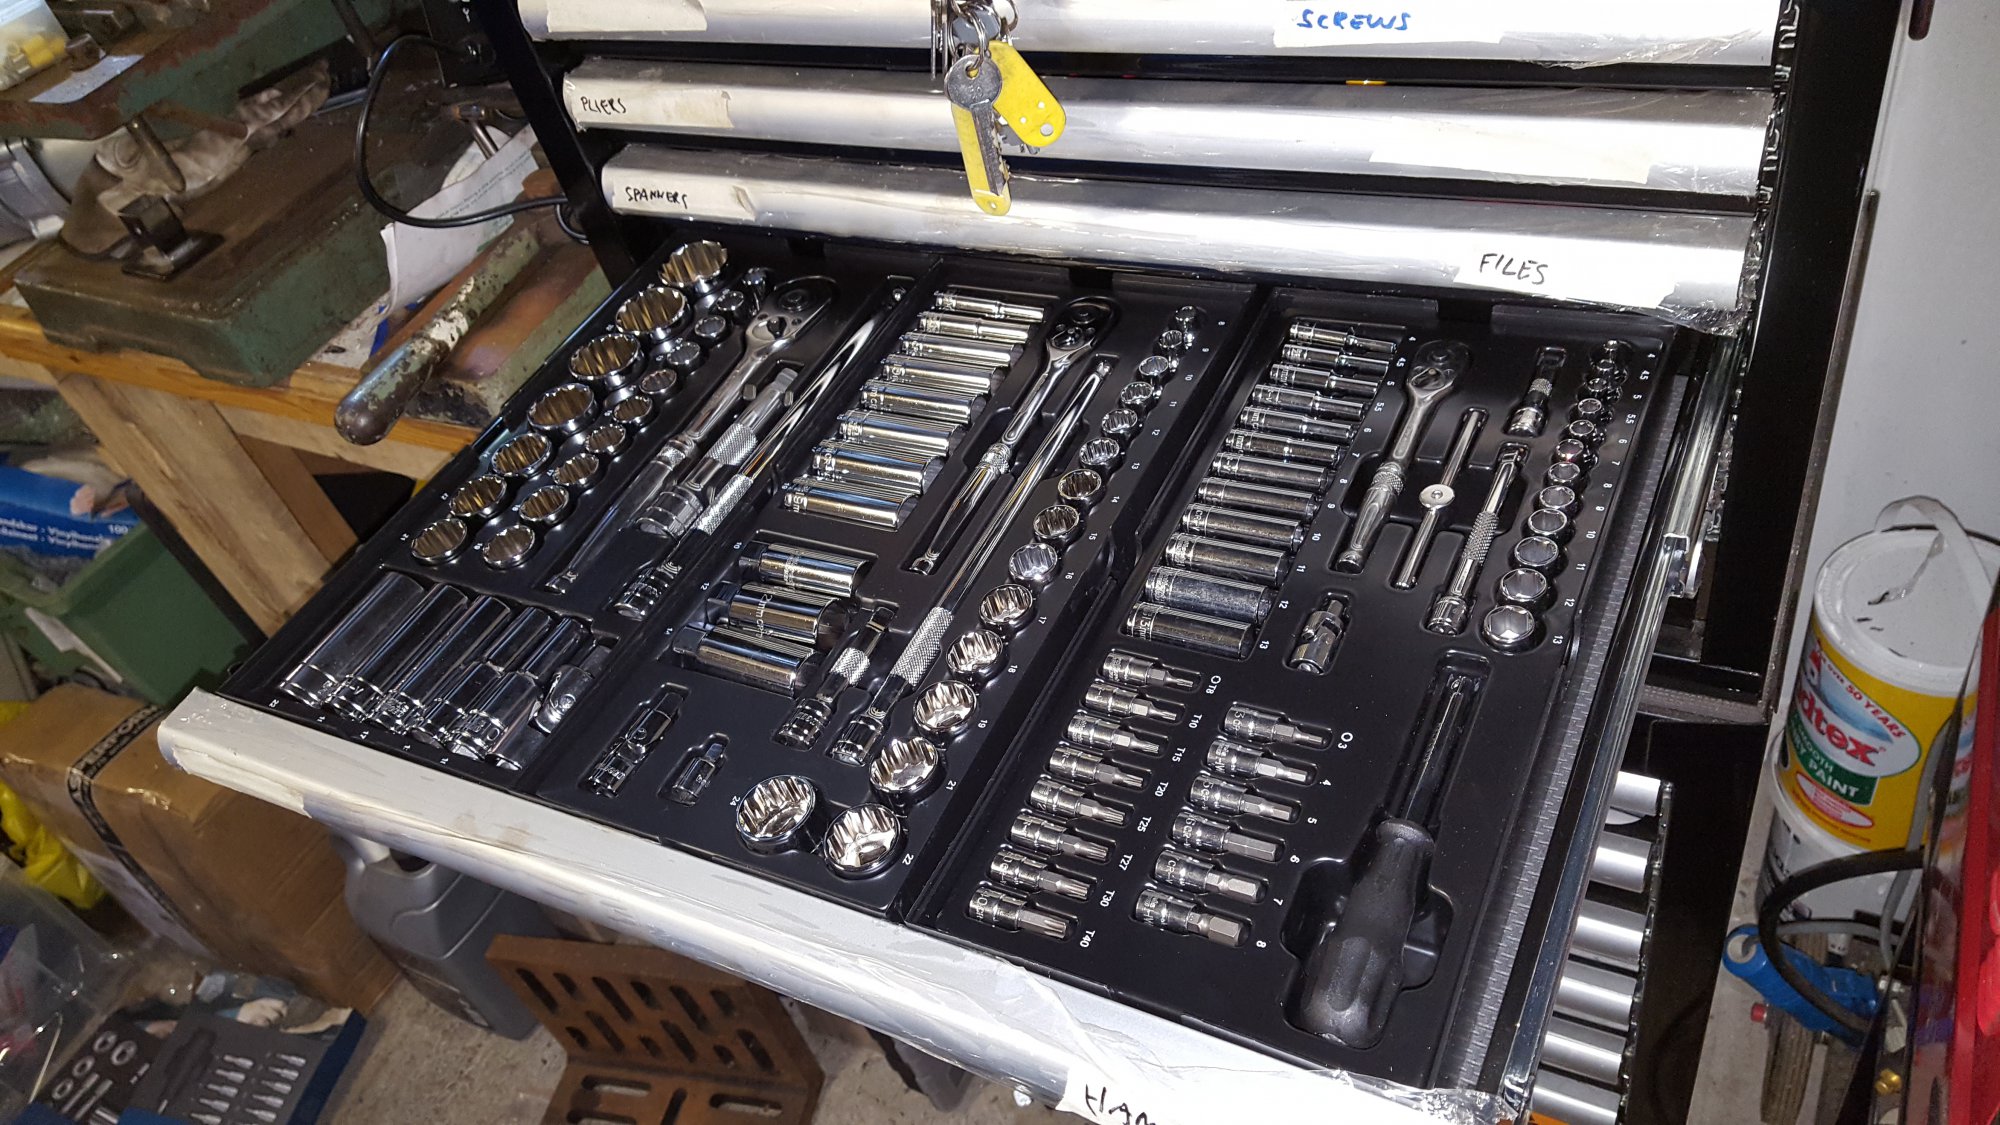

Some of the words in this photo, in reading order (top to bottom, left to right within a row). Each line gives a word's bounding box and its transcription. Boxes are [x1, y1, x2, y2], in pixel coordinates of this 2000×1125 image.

[1297, 9, 1412, 31] SCREWS
[581, 96, 627, 115] PLIERS
[1479, 253, 1548, 286] FILES
[1131, 462, 1141, 470] 13
[1088, 532, 1098, 541] 15
[1311, 532, 1322, 541] 10
[1585, 530, 1597, 539] 10
[733, 542, 743, 550] 10
[1296, 565, 1306, 573] 11
[1575, 563, 1586, 571] 11
[1064, 572, 1075, 580] 16
[700, 582, 710, 591] 12
[1278, 600, 1289, 609] 12
[1564, 598, 1576, 607] 12
[1038, 616, 1047, 625] 17
[1259, 640, 1270, 650] 13
[1552, 635, 1564, 645] 13
[1007, 664, 1018, 674] 18
[1205, 684, 1218, 695] T8
[977, 719, 988, 729] 19
[1188, 714, 1203, 729] T10
[1864, 700, 1907, 739] YEARS
[1337, 742, 1348, 750] 3
[1171, 747, 1186, 763] T15
[1808, 758, 1860, 798] PAINT
[945, 780, 957, 791] 21
[1154, 782, 1169, 797] T20
[729, 795, 741, 807] 24
[1137, 816, 1152, 833] T25
[1307, 816, 1318, 825] 5
[901, 853, 915, 866] 22
[1118, 854, 1134, 871] T27
[1289, 854, 1301, 864] 6
[1099, 890, 1116, 907] T30
[1273, 898, 1284, 906] 7
[1079, 930, 1096, 948] T40
[1255, 940, 1267, 949] 8
